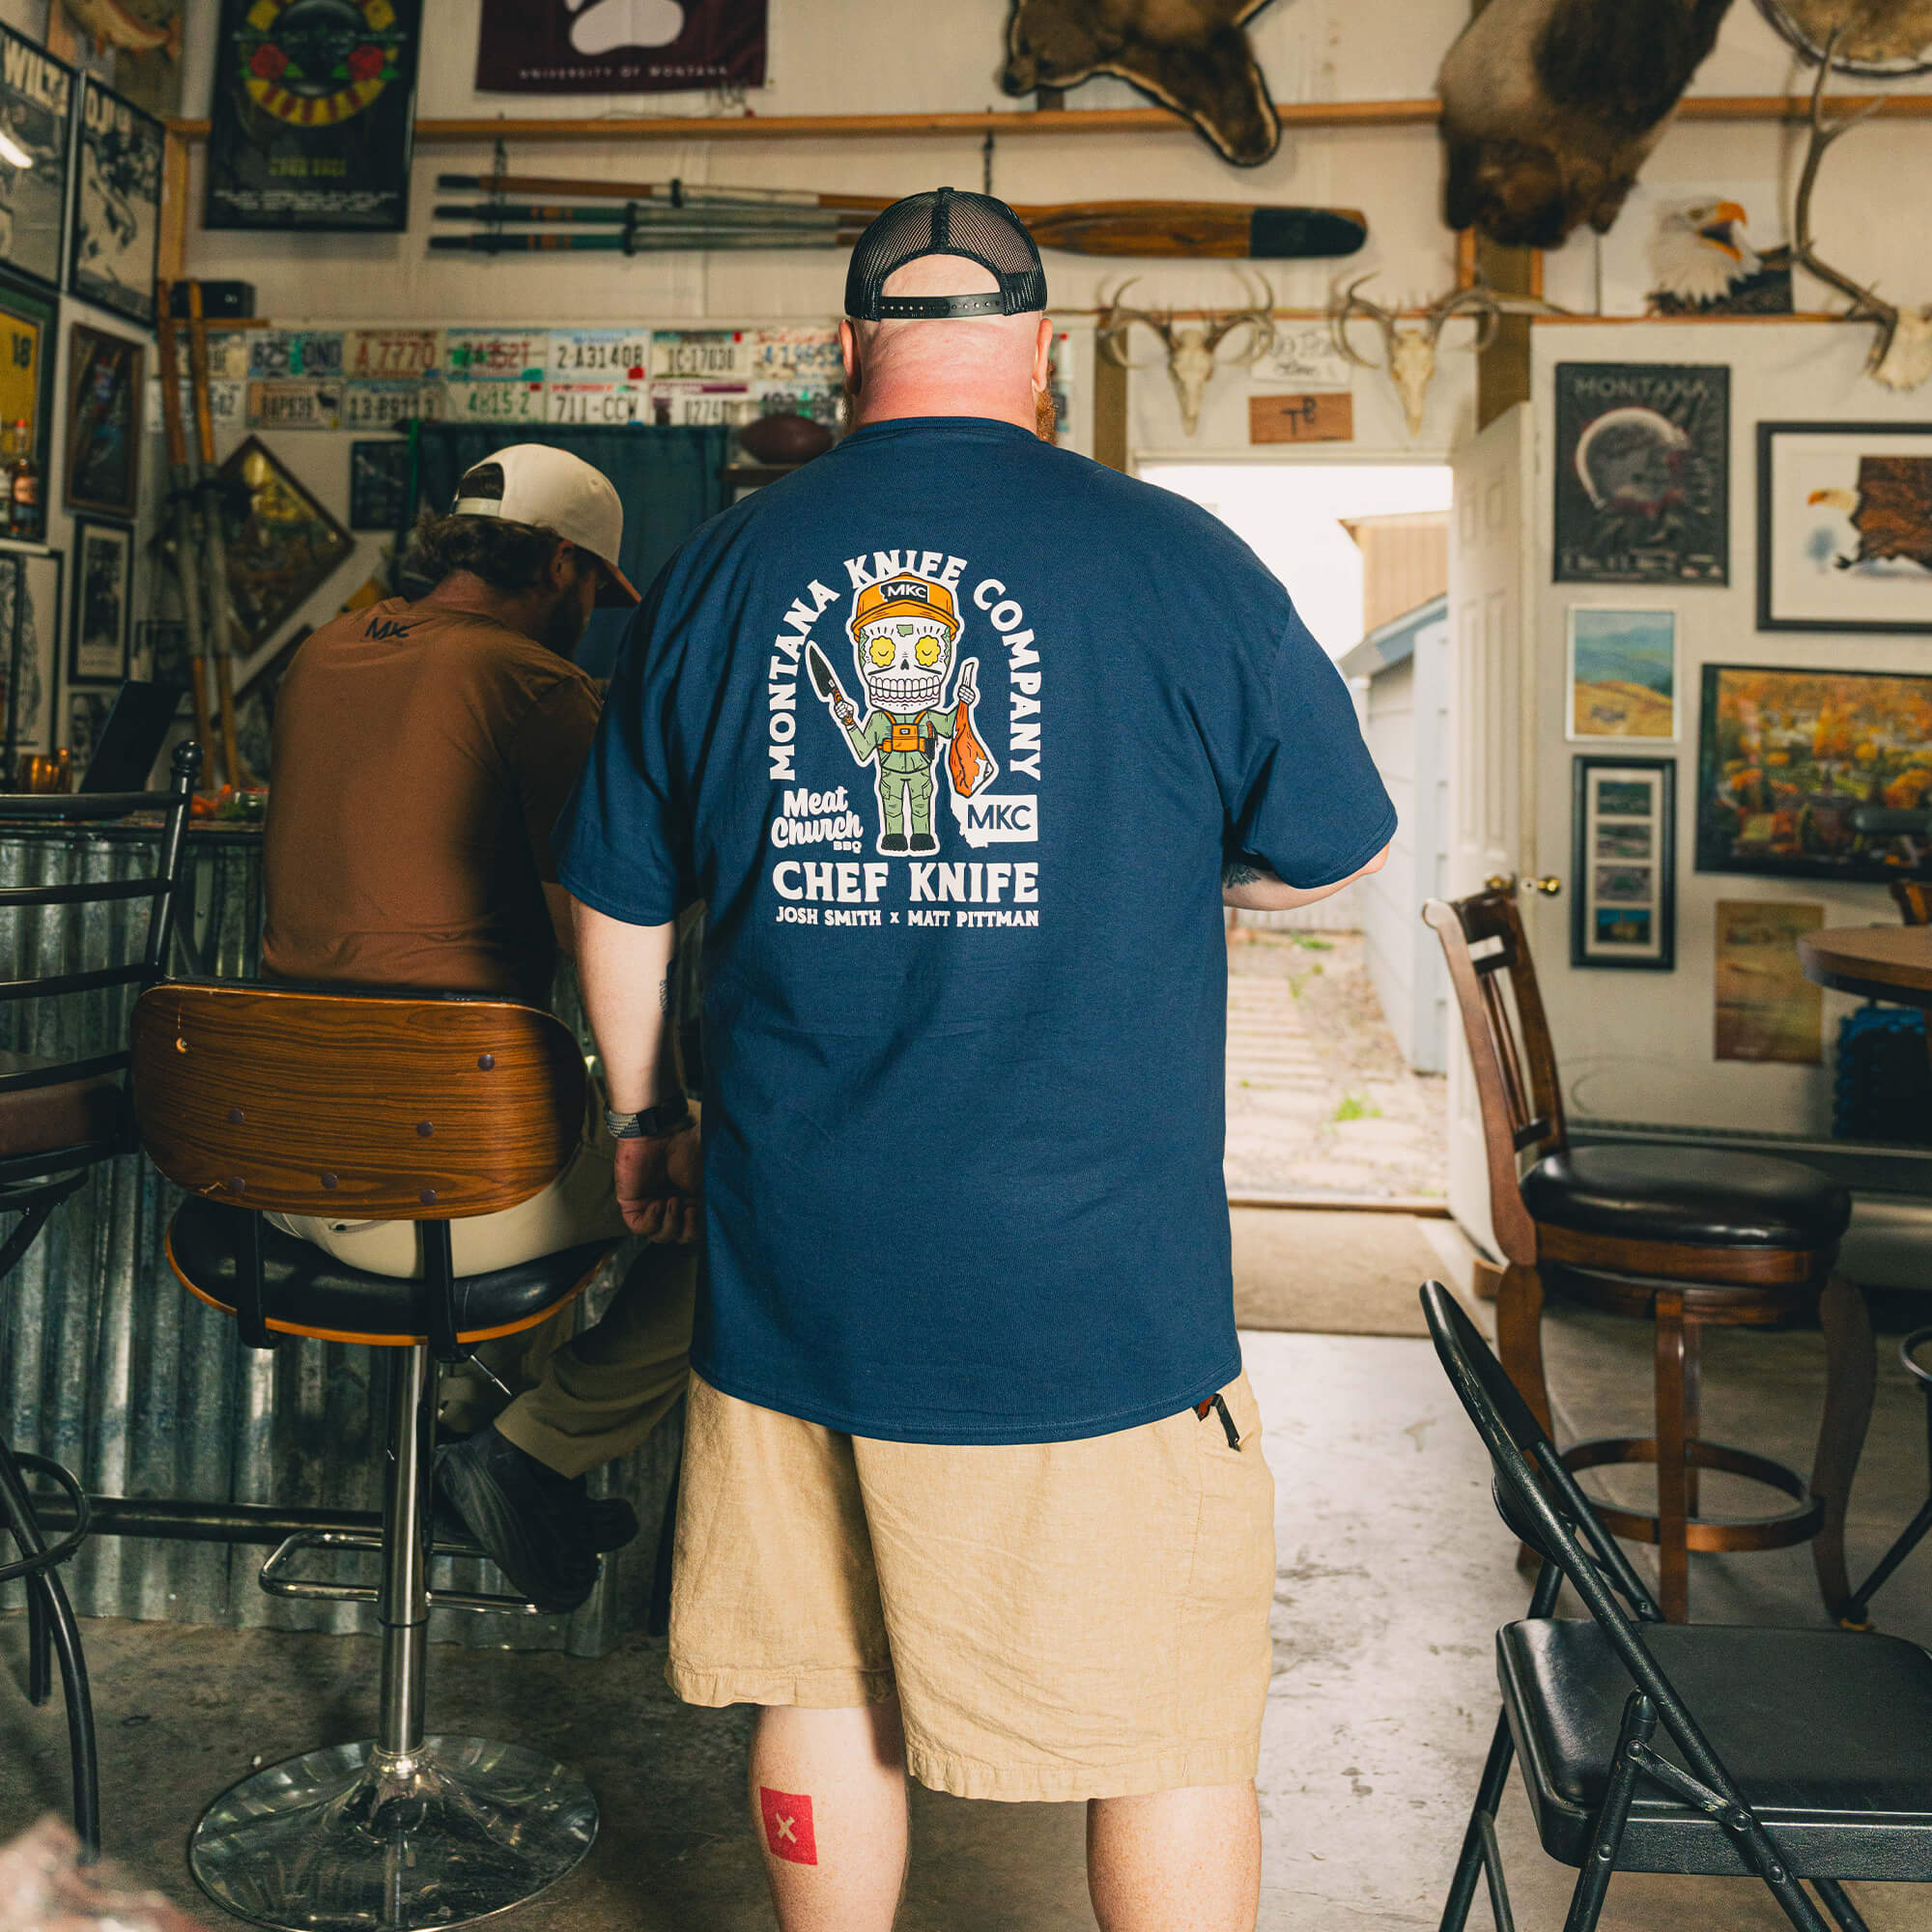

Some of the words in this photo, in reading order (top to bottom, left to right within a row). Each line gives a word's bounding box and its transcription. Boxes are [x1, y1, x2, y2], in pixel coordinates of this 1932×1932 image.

[620, 67, 640, 77] OF
[1575, 377, 1709, 399] MONTANA
[887, 583, 927, 600] MKC
[769, 580, 840, 781] MONTANA
[843, 549, 967, 588] KNIFE
[973, 579, 1041, 781] COMPANY
[783, 785, 848, 818] Meat
[771, 810, 864, 849] Church
[967, 804, 1032, 831] MKC
[772, 861, 889, 903] CHEF
[908, 862, 1038, 903] KNIFE
[776, 906, 819, 925] JOSH
[824, 909, 882, 927] SMITH
[907, 910, 951, 927] MATT
[956, 911, 1039, 927] PITTMAN
